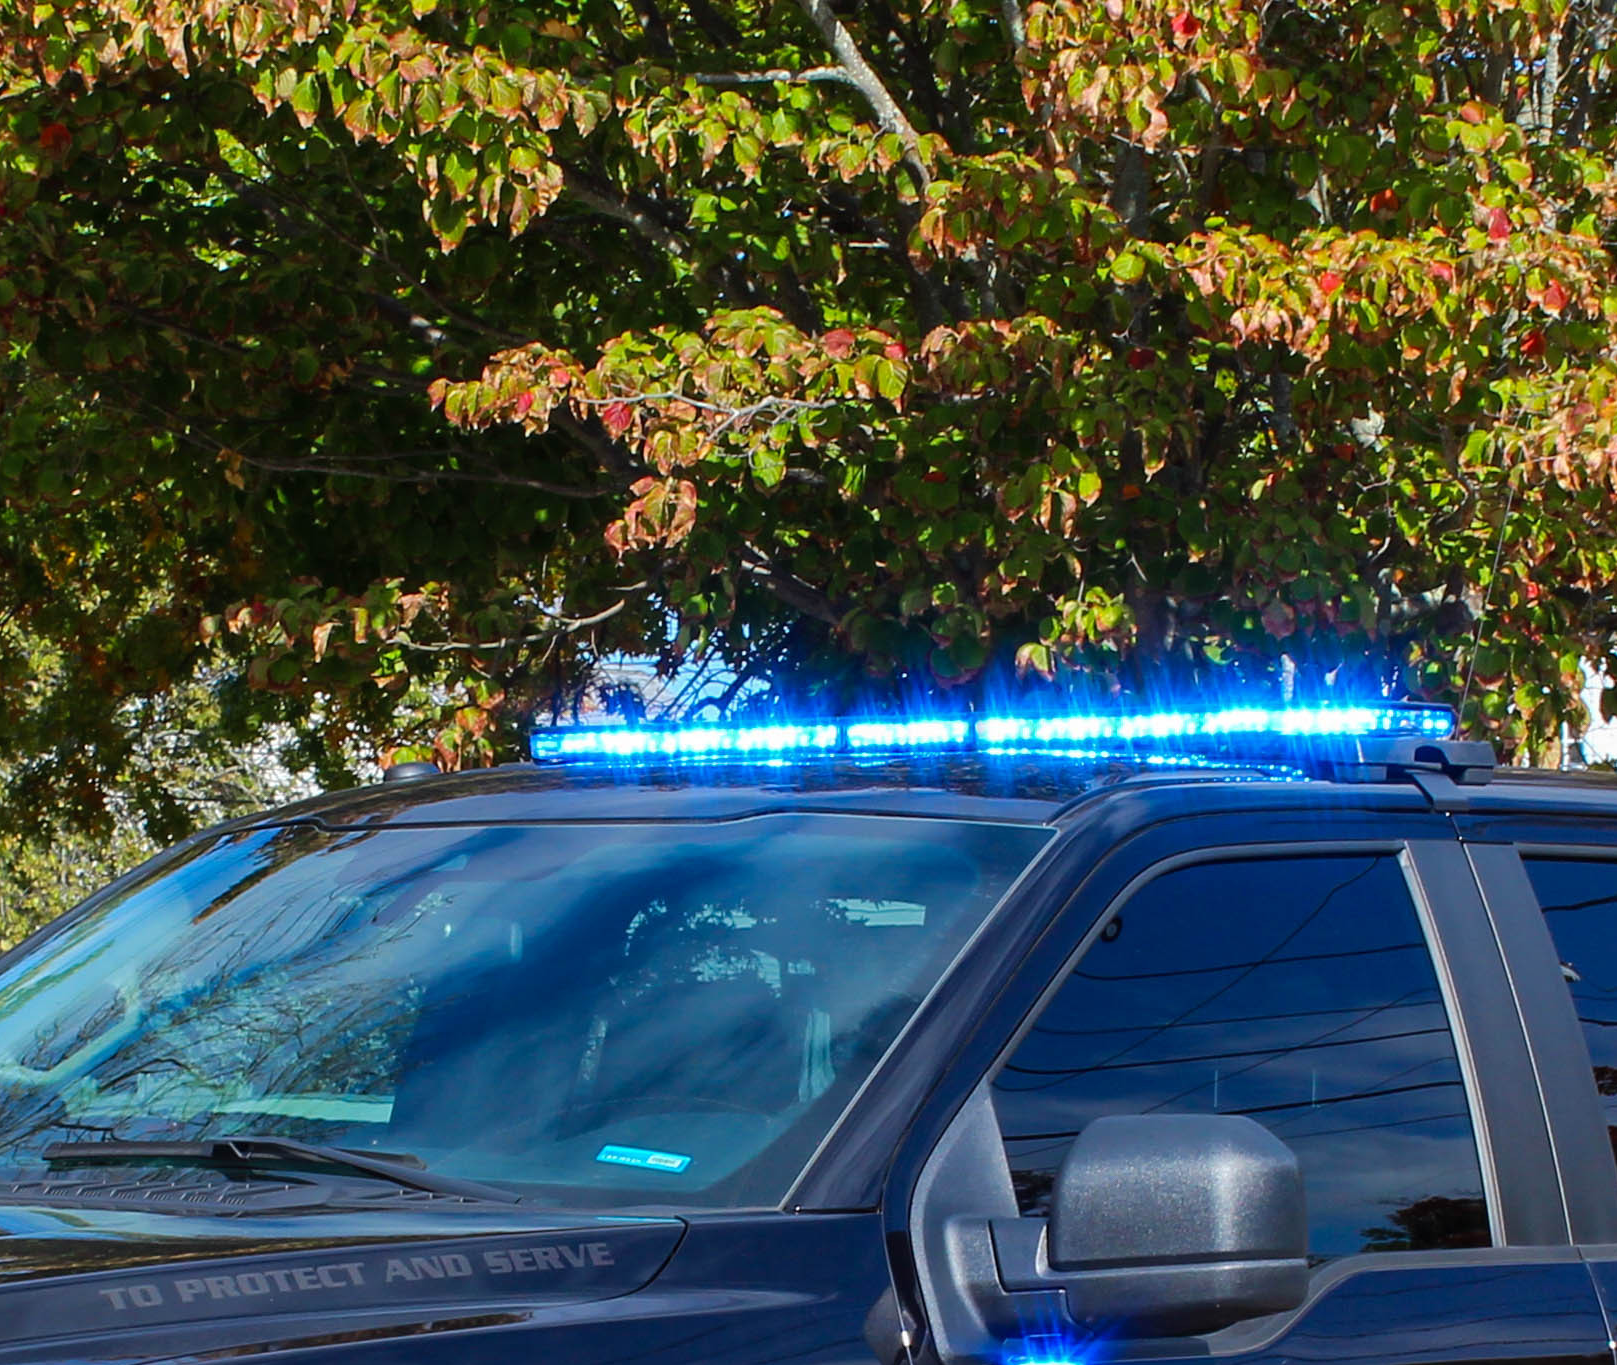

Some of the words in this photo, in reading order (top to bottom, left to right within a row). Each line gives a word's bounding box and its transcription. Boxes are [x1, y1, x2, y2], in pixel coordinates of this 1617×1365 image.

[99, 1285, 163, 1311] TO
[174, 1262, 366, 1302] PROTECT
[385, 1253, 473, 1283] AND
[484, 1242, 614, 1274] SERVE
